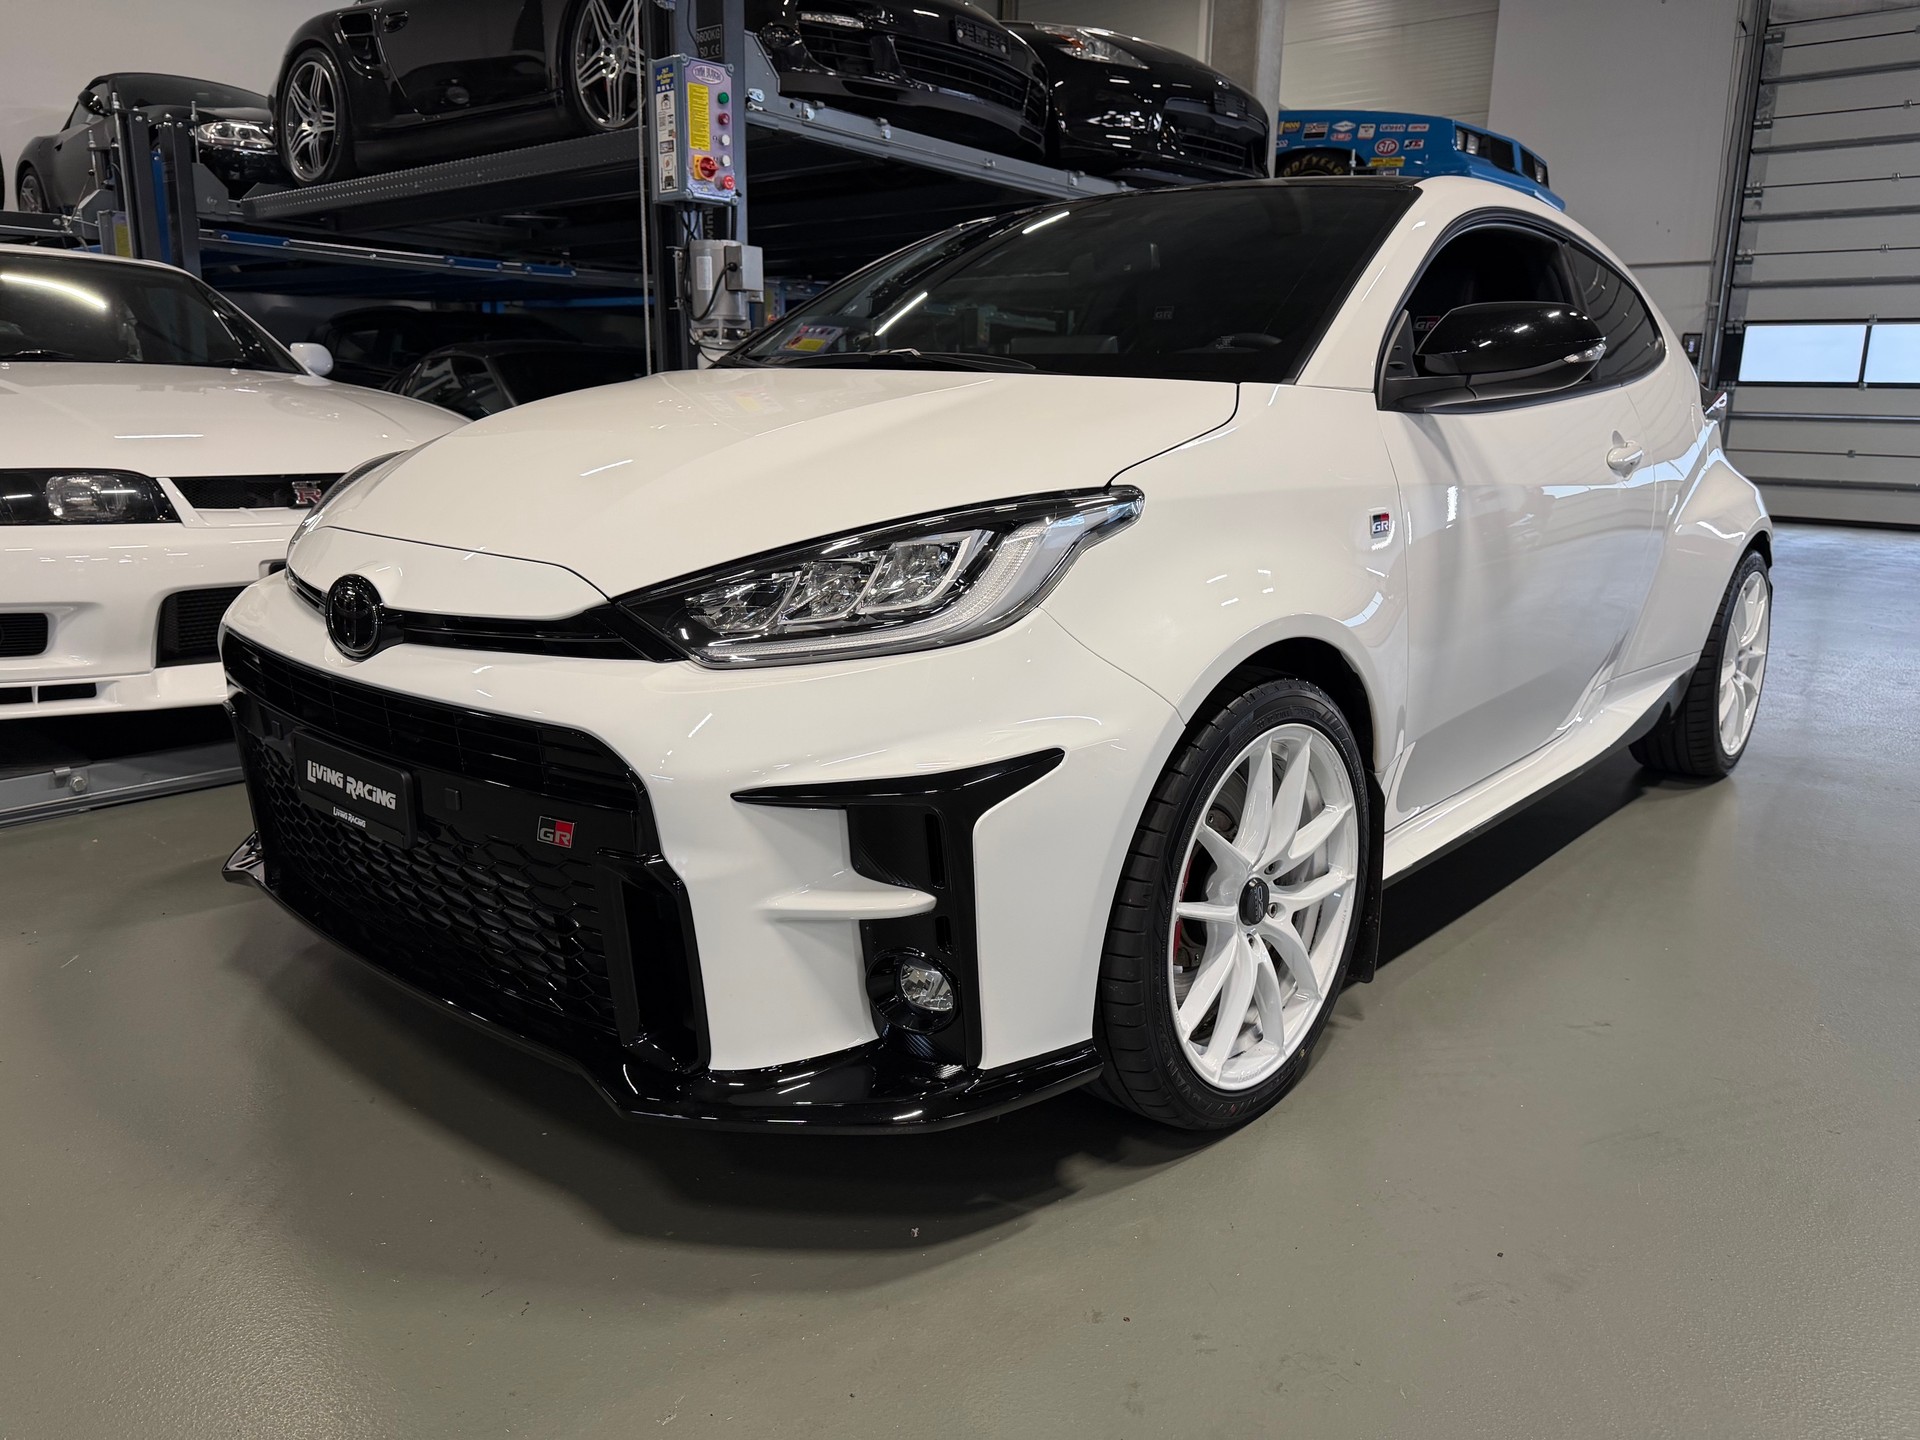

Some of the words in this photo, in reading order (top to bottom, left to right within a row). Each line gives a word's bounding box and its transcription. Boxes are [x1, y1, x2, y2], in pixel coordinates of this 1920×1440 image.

[1378, 140, 1397, 152] STP
[1372, 520, 1389, 532] GR
[540, 827, 571, 846] GR
